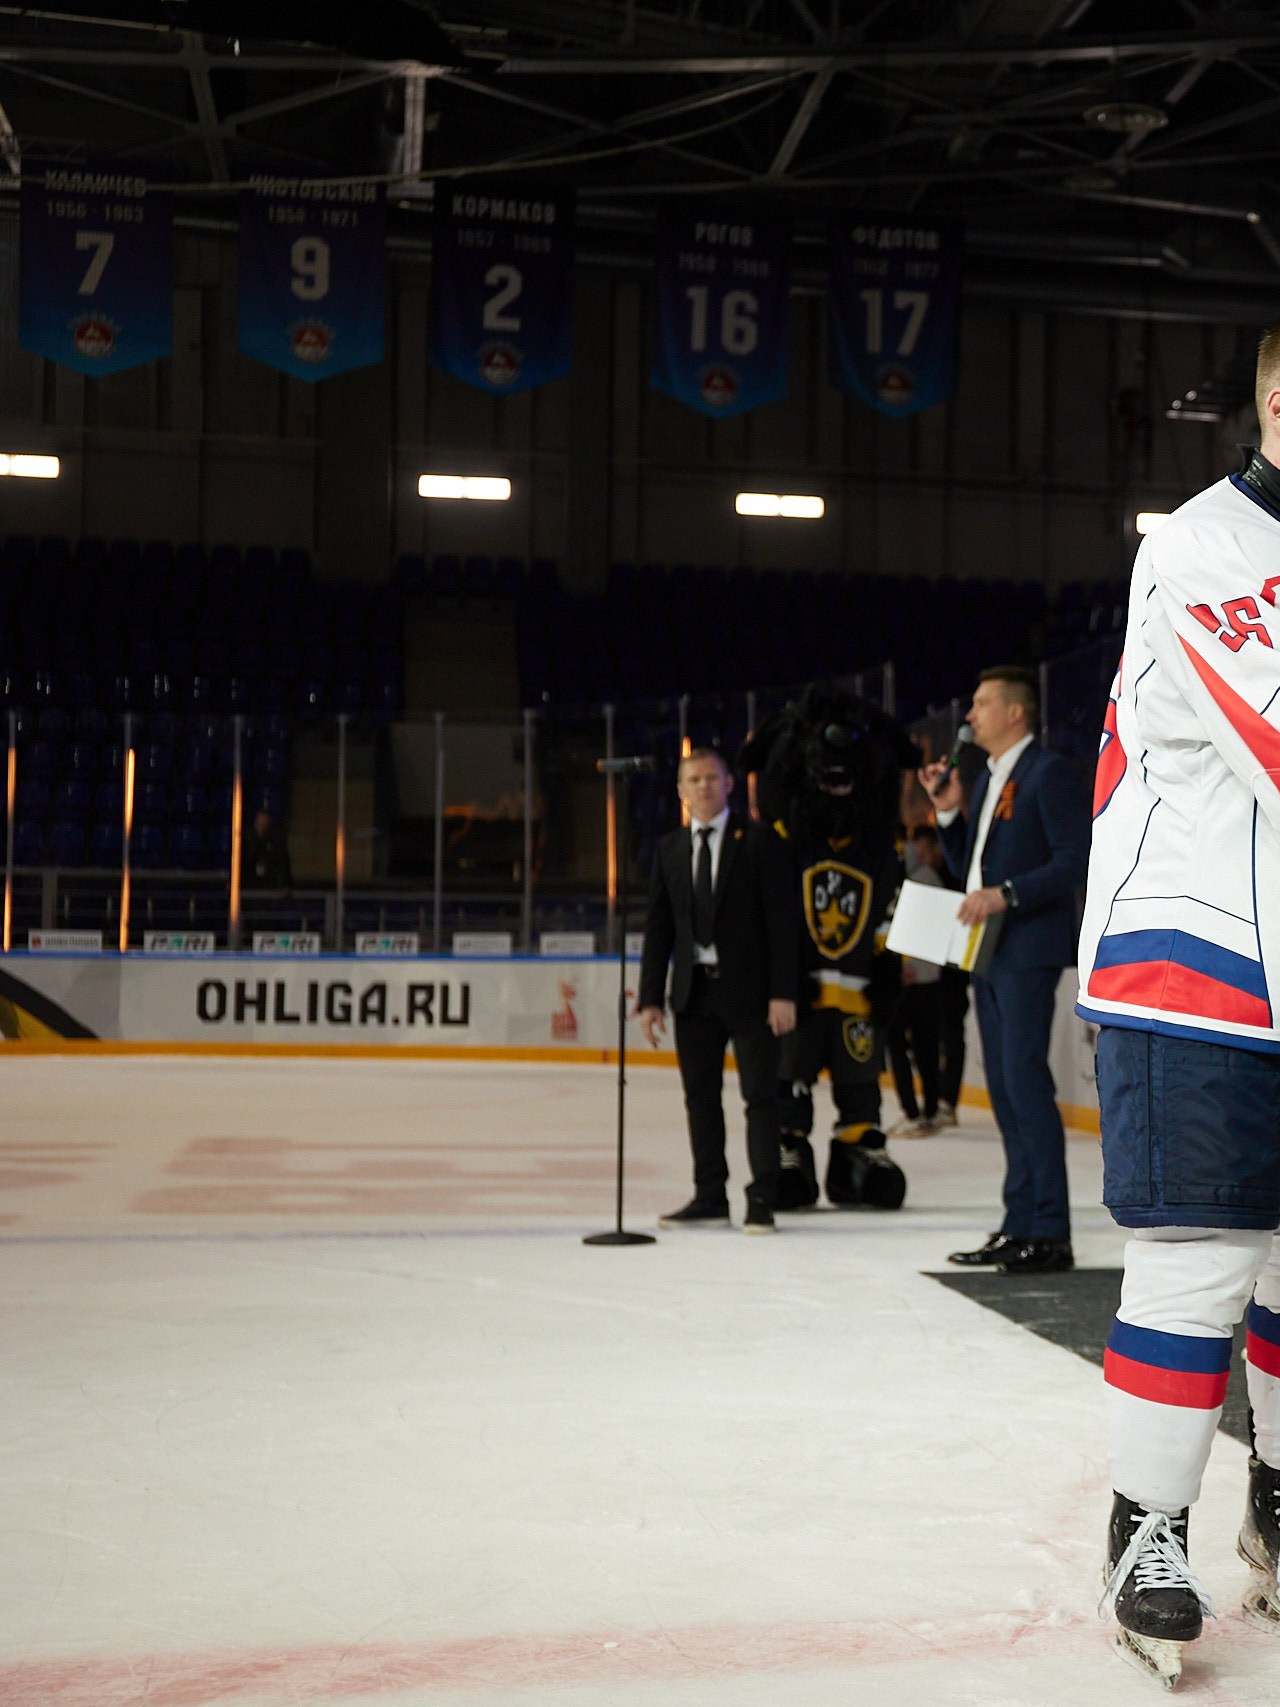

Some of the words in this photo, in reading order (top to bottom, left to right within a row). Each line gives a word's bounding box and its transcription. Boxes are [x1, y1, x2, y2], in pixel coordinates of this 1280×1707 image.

[74, 230, 116, 297] 7
[289, 235, 331, 303] 9
[482, 262, 525, 334] 2
[686, 284, 760, 357] 16
[860, 287, 931, 358] 17
[196, 978, 471, 1028] OHLIGA.RU
